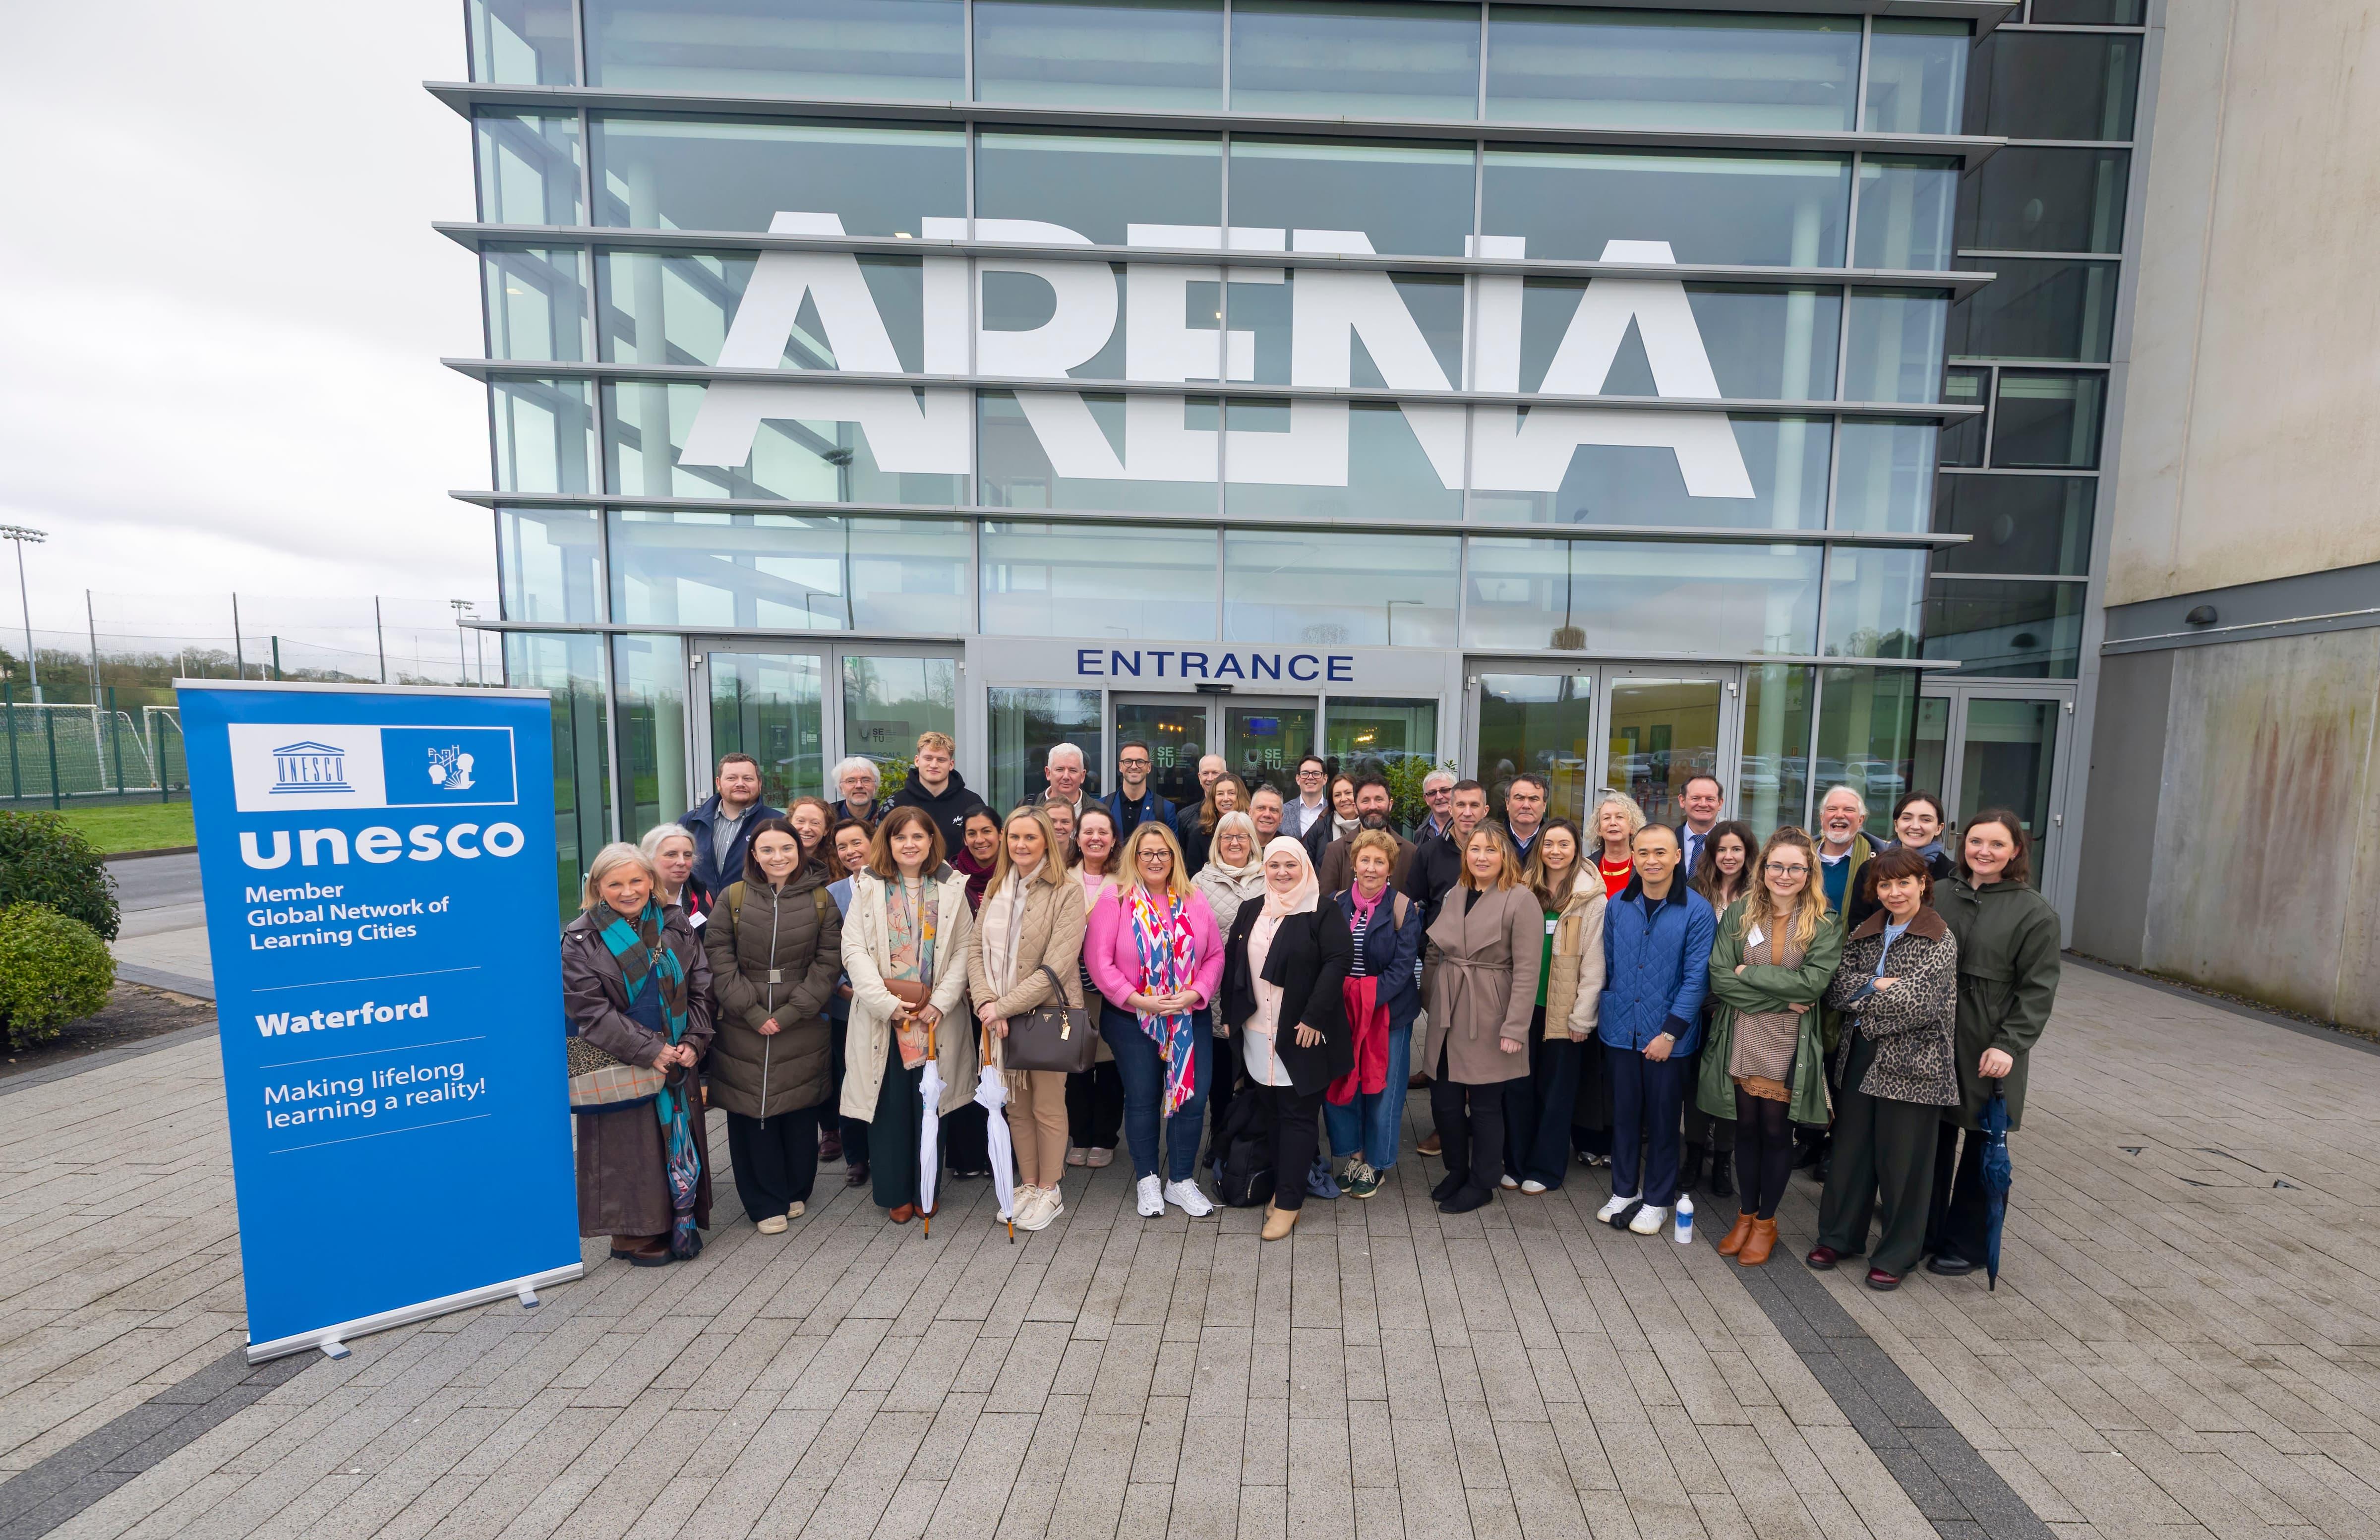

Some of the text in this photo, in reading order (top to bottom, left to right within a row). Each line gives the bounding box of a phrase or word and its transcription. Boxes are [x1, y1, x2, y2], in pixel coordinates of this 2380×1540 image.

[677, 211, 1756, 498] ARENA
[1078, 650, 1353, 681] ENTRANCE
[1157, 746, 1174, 757] SE
[1157, 758, 1174, 768] TU
[1264, 749, 1281, 759] SE
[1264, 760, 1281, 770] TU
[278, 757, 343, 782] UNESCO
[239, 823, 524, 870] unesco
[246, 883, 344, 903] Member
[247, 896, 449, 926] Global Network of
[250, 923, 416, 950] Learning Cities
[255, 996, 428, 1037] Waterford
[265, 1063, 464, 1105] Making lifelong
[267, 1078, 485, 1128] learning a reality!
